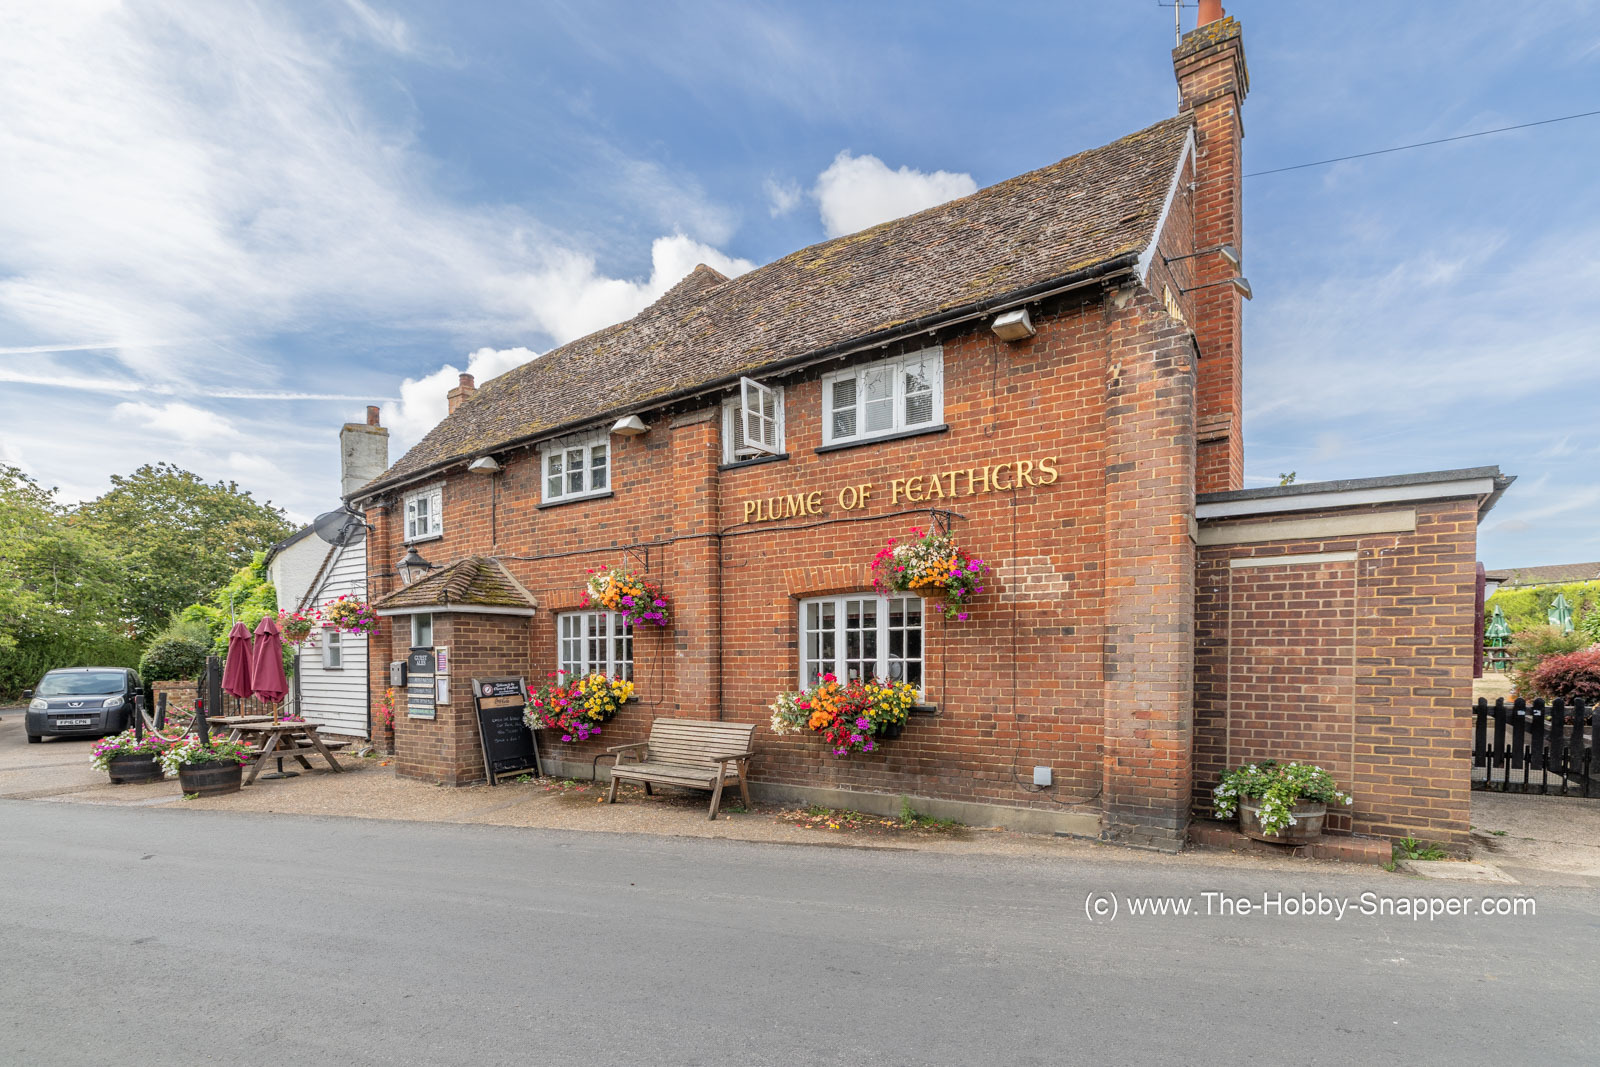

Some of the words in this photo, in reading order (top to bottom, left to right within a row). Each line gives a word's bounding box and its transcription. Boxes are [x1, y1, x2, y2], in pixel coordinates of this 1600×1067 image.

[743, 491, 823, 523] PLUME
[838, 483, 873, 510] OF
[891, 456, 1058, 505] FEATHERS
